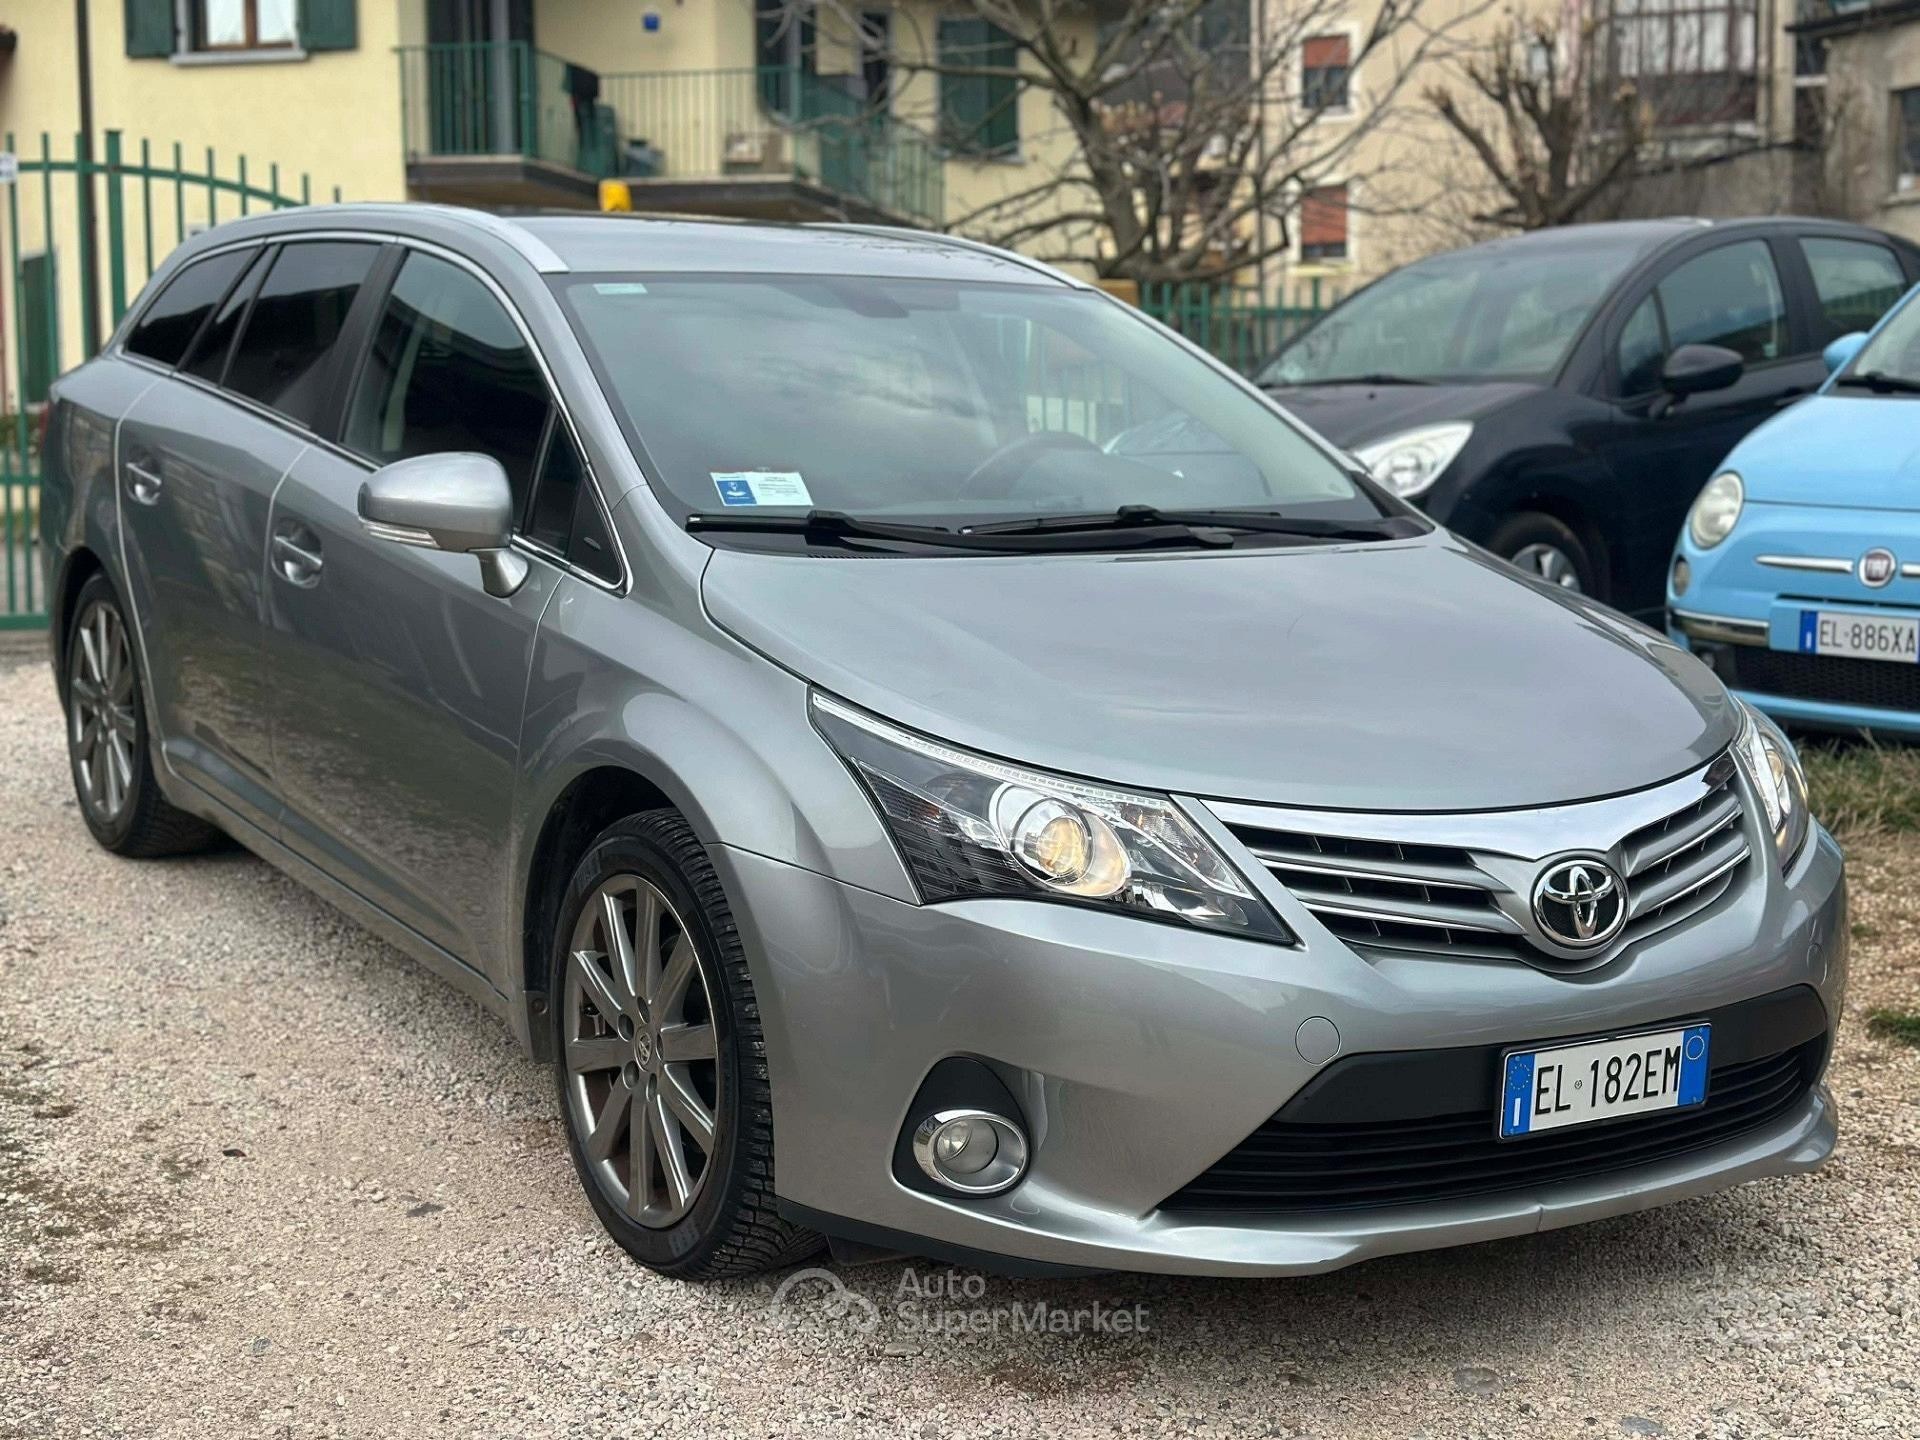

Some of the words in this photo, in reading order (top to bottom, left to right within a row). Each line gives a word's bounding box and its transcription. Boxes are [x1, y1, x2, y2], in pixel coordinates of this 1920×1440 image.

[1819, 620, 1842, 648] EL
[1850, 623, 1916, 653] 886XA
[1535, 1064, 1571, 1116] EL
[1590, 1045, 1682, 1108] 182EM
